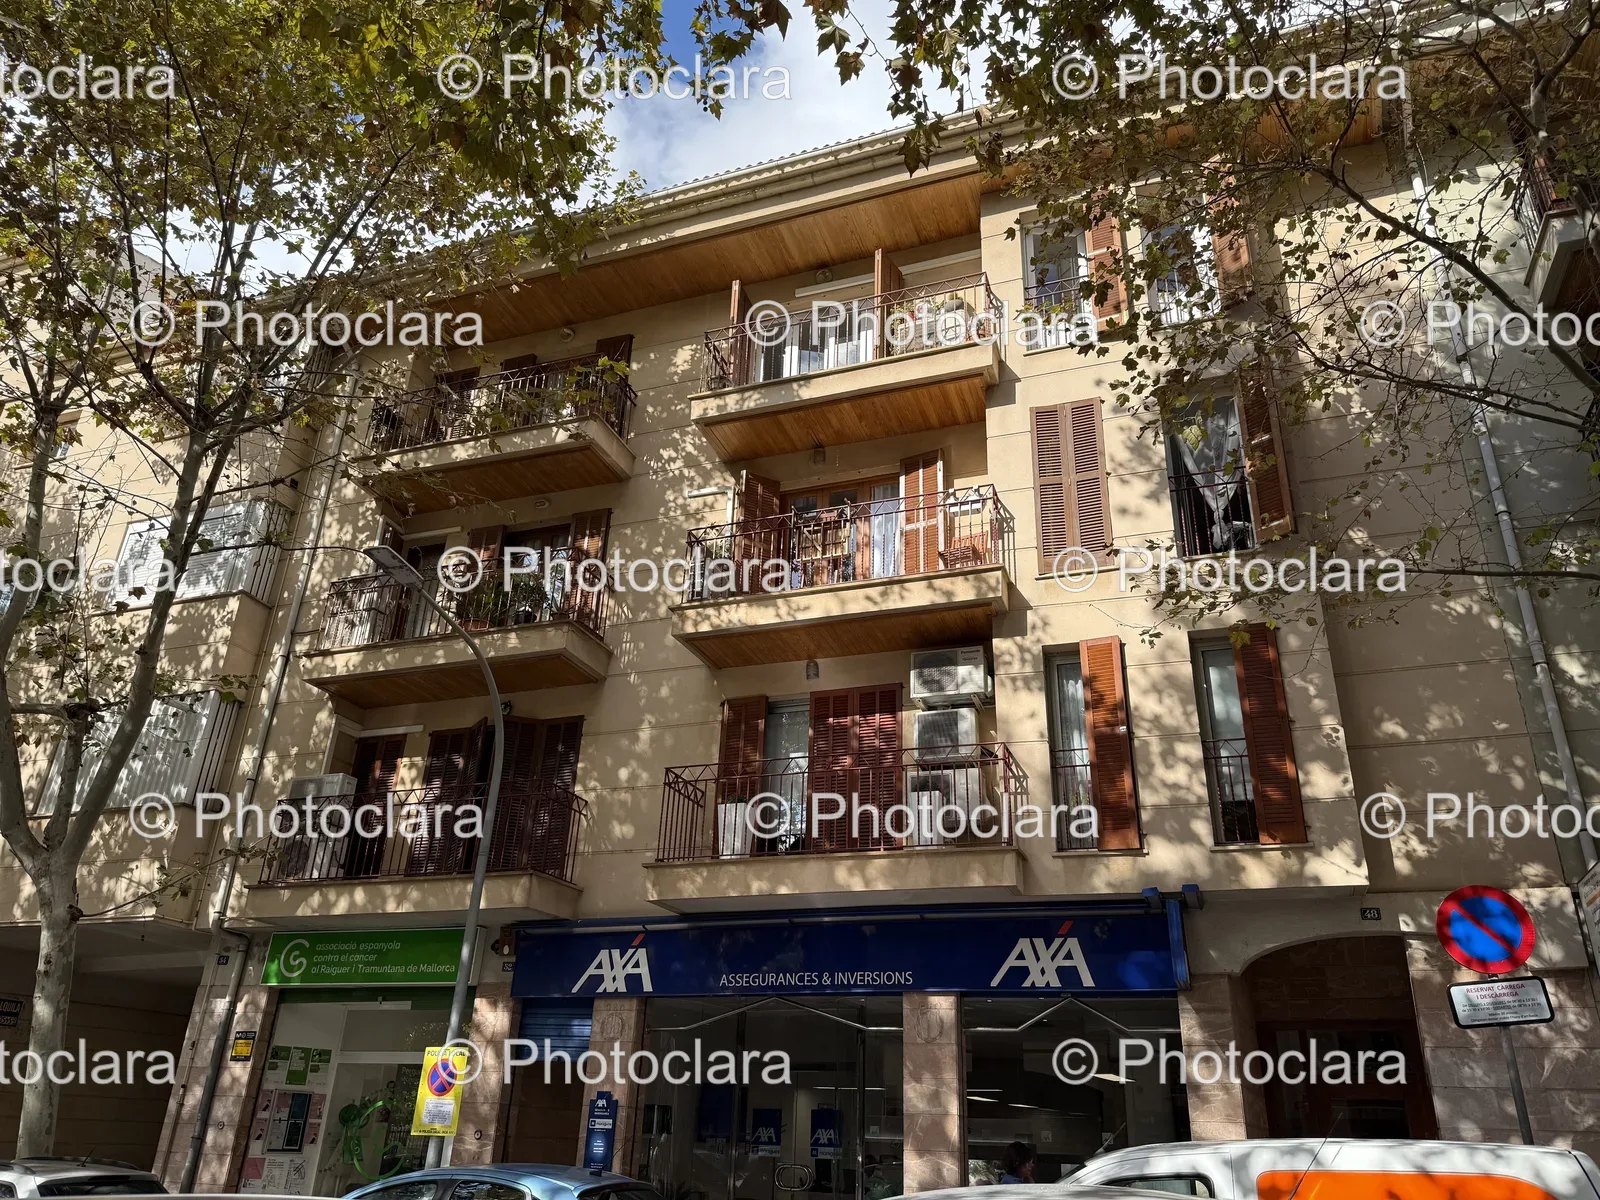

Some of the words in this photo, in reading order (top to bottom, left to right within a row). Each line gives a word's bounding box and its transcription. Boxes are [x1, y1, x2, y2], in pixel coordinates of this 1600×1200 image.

[1365, 909, 1378, 918] 48
[316, 941, 357, 951] associació
[360, 940, 401, 951] espanyola
[313, 954, 339, 962] contra
[340, 953, 349, 961] el
[990, 937, 1096, 987] AXA
[311, 965, 319, 974] al
[320, 965, 351, 975] Raiguer
[358, 964, 405, 973] Tramuntana
[407, 964, 418, 972] de
[419, 964, 455, 972] Mallorca
[571, 947, 653, 993] AXA
[720, 972, 819, 987] ASSEGURANCES
[822, 972, 831, 985] &
[834, 971, 913, 985] INVERSIONS
[1466, 986, 1494, 994] RESERVAT
[1497, 983, 1525, 991] CÀRREGA
[1480, 991, 1519, 1000] DESCÀRREGA
[751, 1126, 776, 1142] AXA
[810, 1128, 838, 1144] AXA
